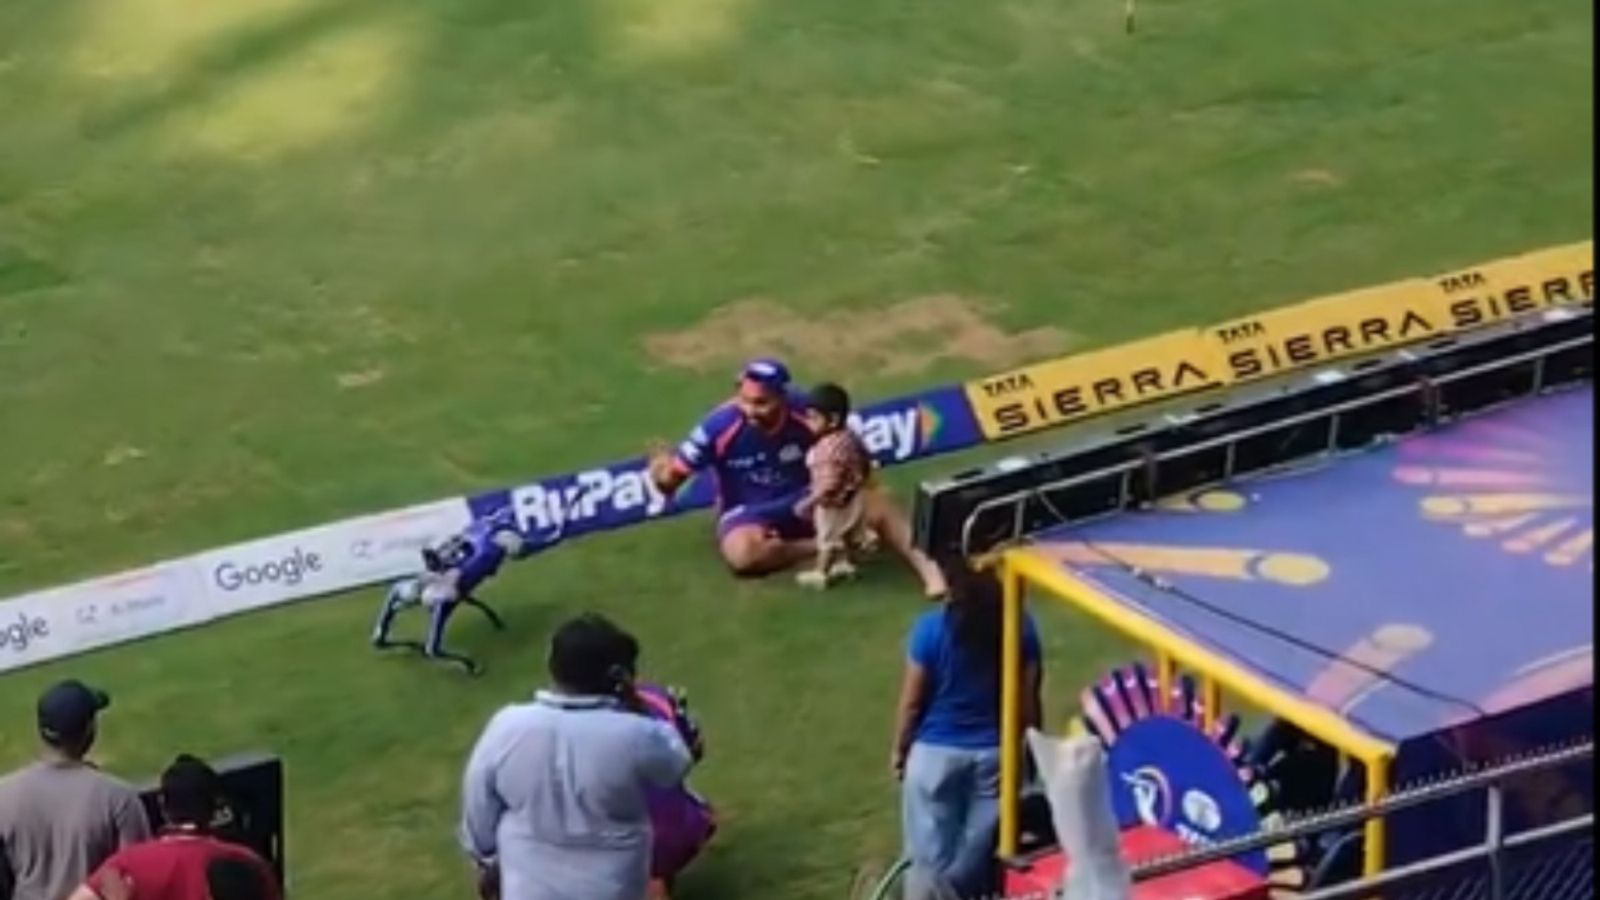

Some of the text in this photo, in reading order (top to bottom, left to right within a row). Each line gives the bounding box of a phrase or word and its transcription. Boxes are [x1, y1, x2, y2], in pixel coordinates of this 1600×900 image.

[1439, 272, 1486, 294] TATA
[1216, 321, 1266, 344] TATA
[1228, 309, 1433, 378] SIERRA
[981, 374, 1034, 398] TATA
[993, 361, 1208, 432] SIERRA
[214, 546, 322, 591] Google
